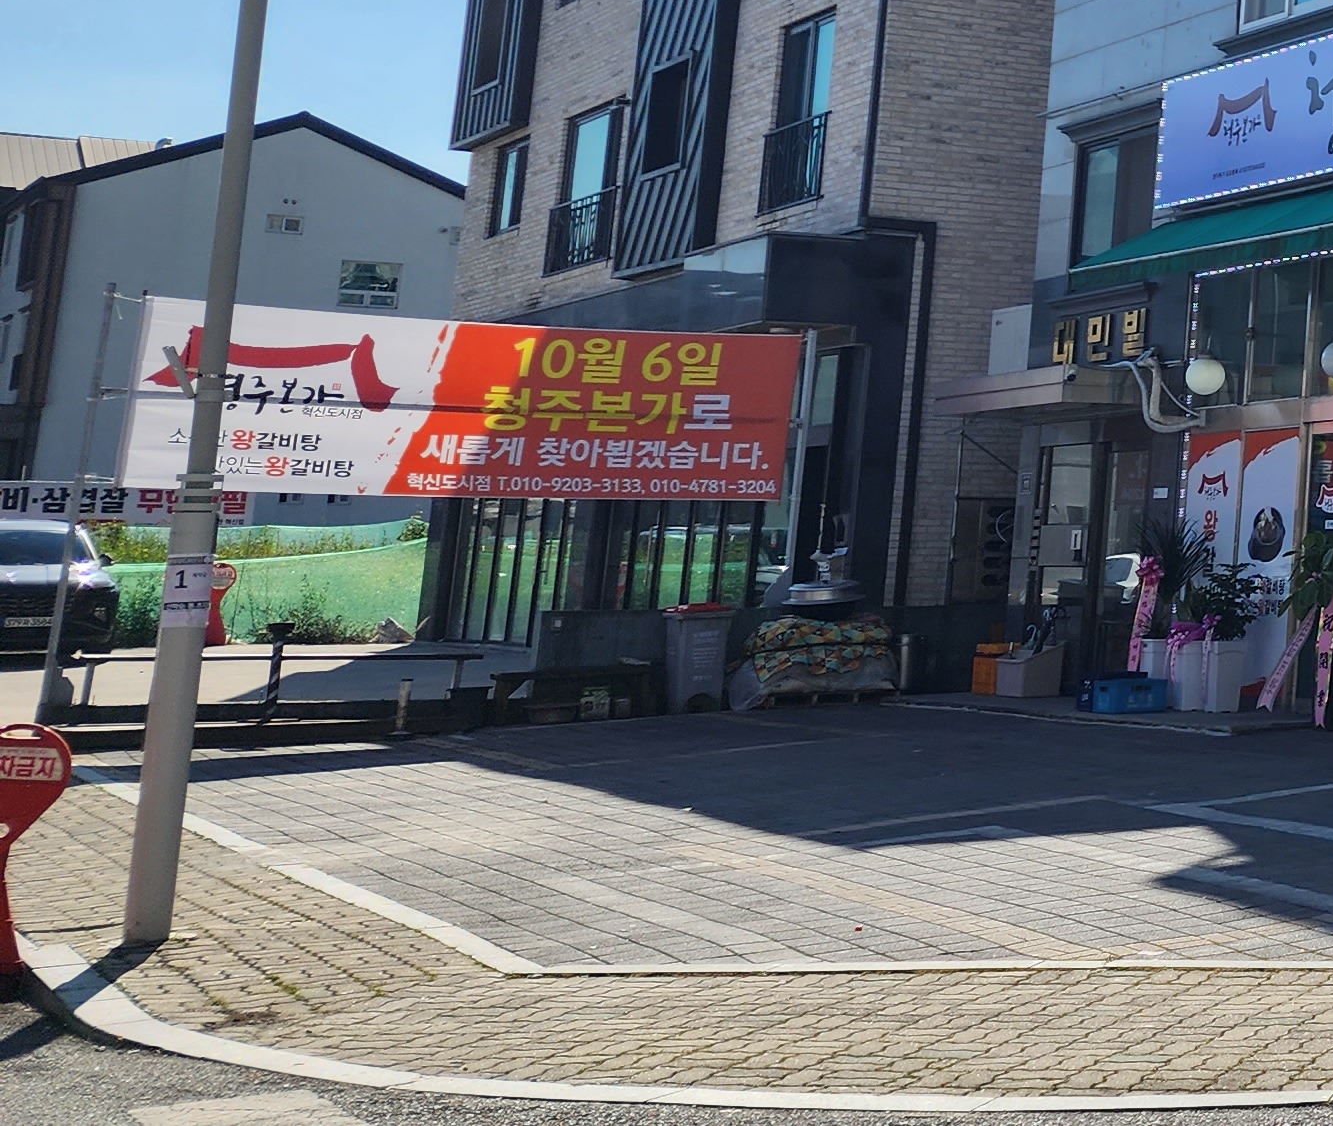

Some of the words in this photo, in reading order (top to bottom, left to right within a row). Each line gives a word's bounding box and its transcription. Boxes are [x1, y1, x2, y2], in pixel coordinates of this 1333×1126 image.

[514, 337, 625, 385] 10월
[642, 341, 723, 386] 6일
[302, 406, 363, 420] 혁신도시점
[484, 385, 733, 434] 청주본가로
[168, 427, 322, 452] 소왕갈비탕
[420, 433, 525, 466] 새롭게
[538, 436, 769, 471] 찾아뵙겠습니다.
[407, 473, 491, 492] 혁신도시점
[498, 474, 645, 495] T.010-9203-3133,
[650, 478, 777, 495] 010-4781-3204
